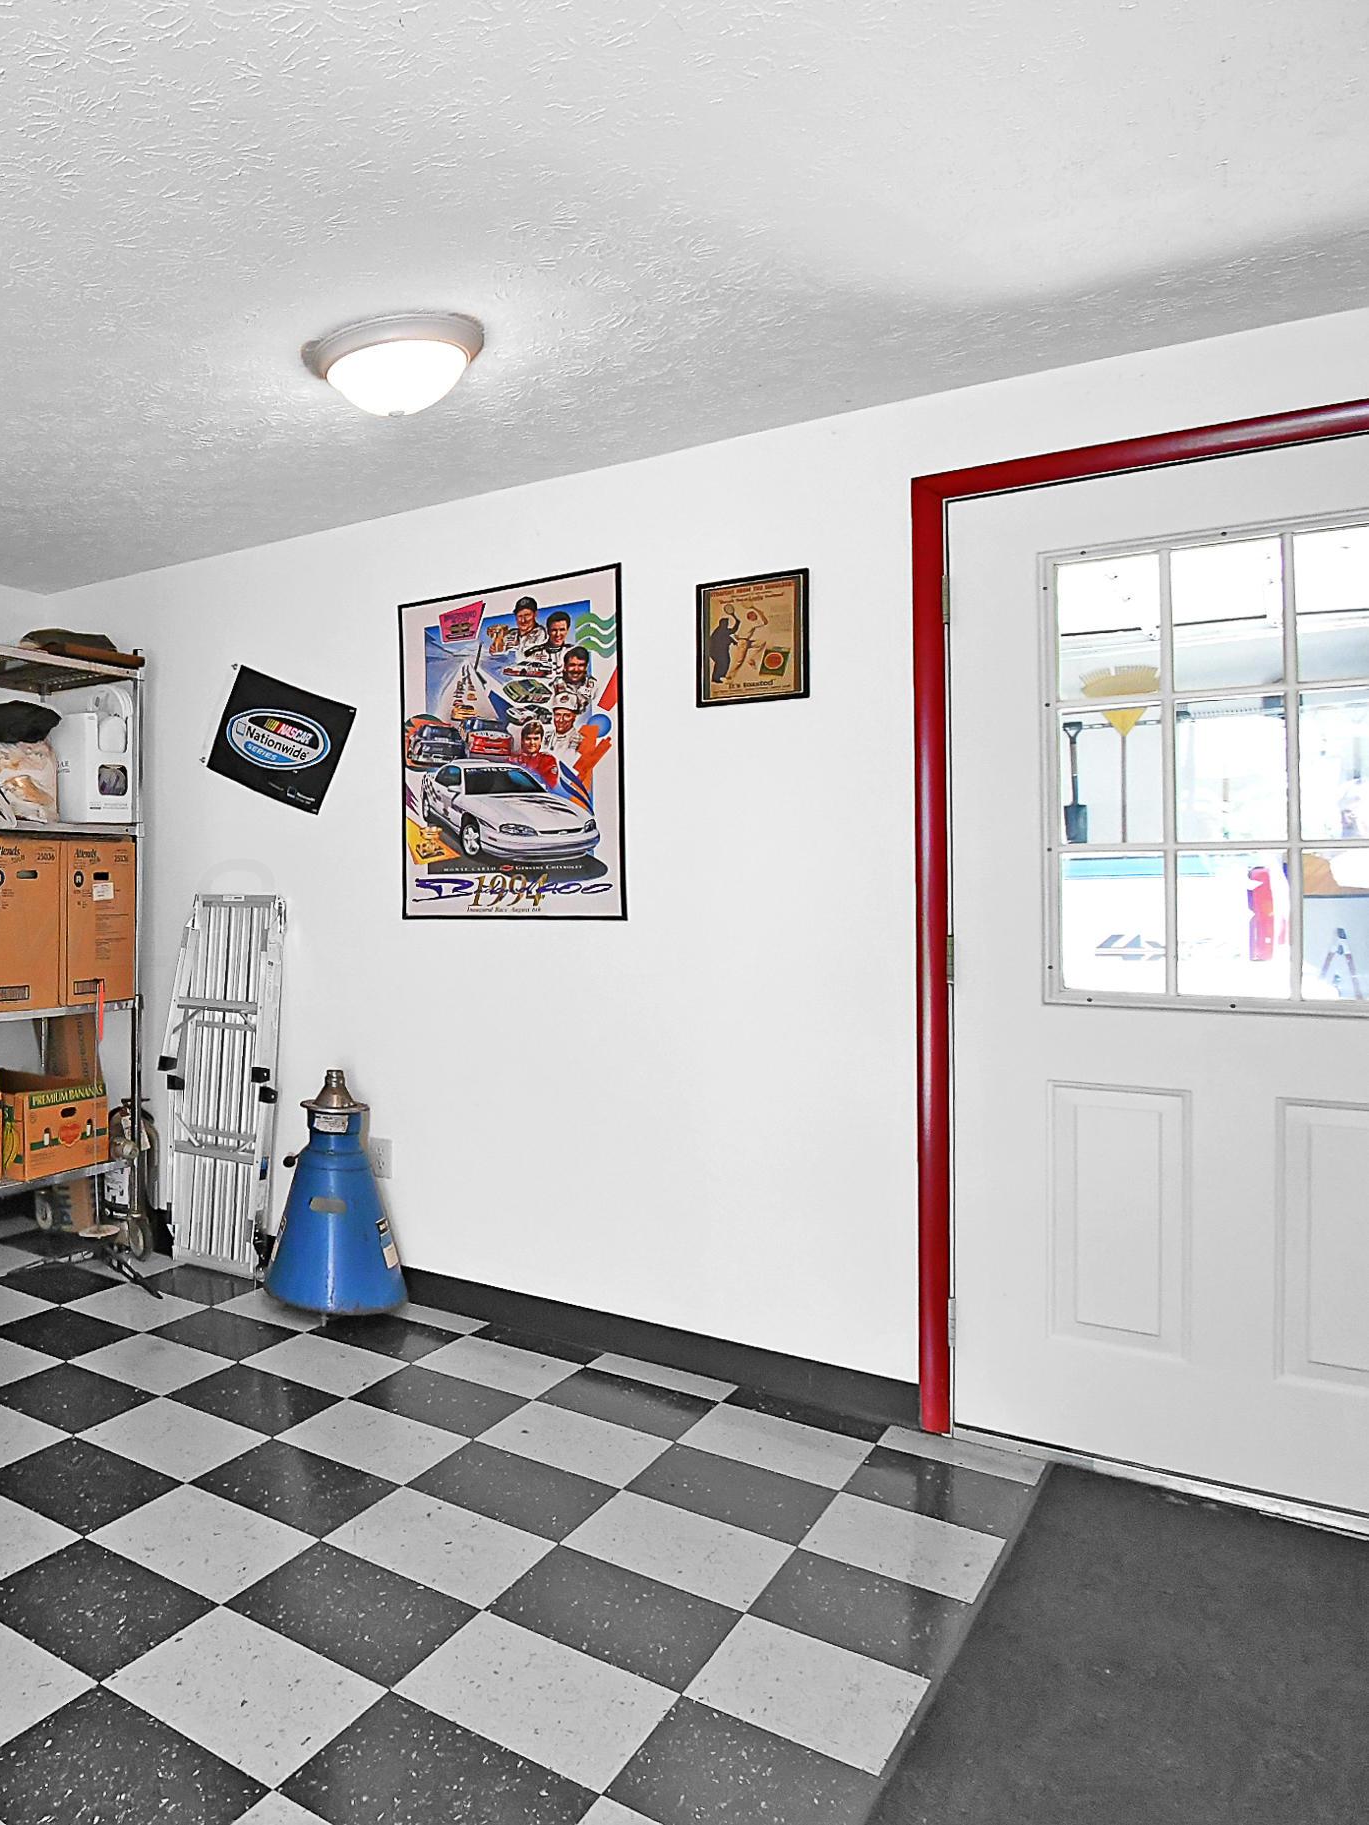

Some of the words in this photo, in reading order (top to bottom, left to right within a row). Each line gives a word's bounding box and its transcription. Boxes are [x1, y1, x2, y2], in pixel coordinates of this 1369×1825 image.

[245, 725, 309, 761] Nationwide
[278, 723, 313, 745] NASCAR
[246, 743, 278, 761] SERIES
[74, 848, 97, 858] Attends
[468, 873, 549, 907] 1994
[32, 1090, 69, 1106] PREMIUM
[69, 1084, 104, 1100] BANANAS
